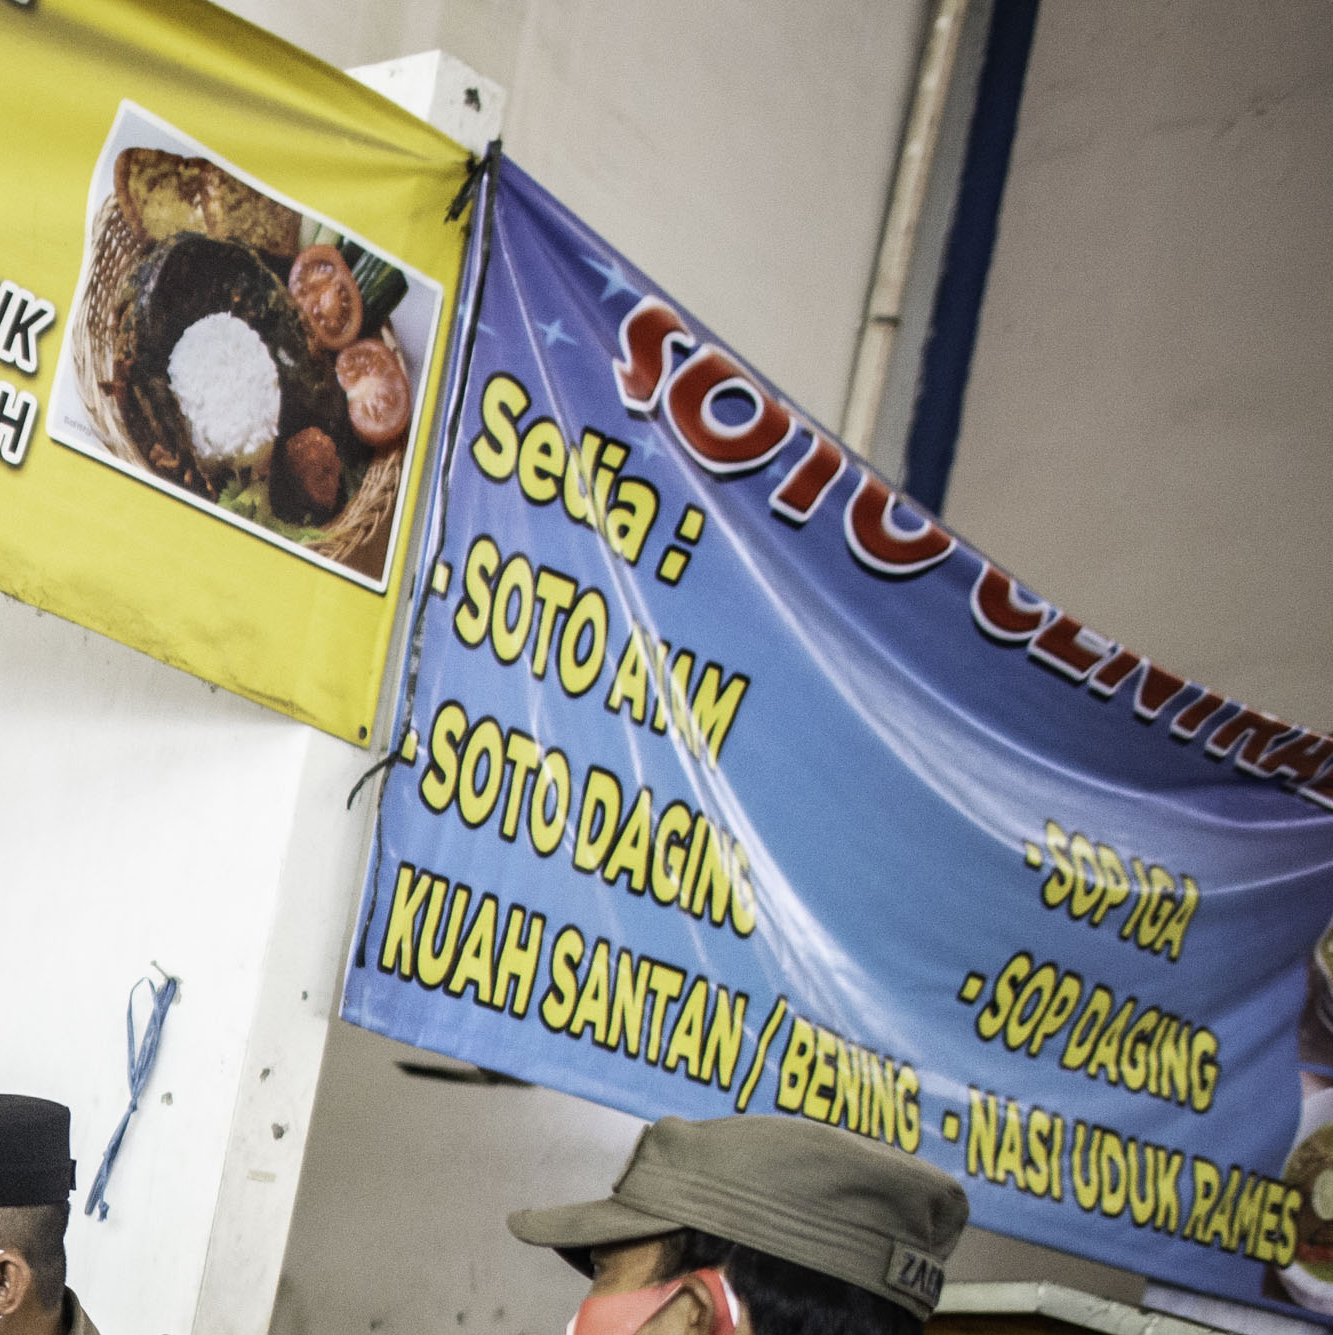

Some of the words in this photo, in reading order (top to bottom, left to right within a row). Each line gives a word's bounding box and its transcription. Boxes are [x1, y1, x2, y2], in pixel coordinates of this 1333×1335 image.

[573, 765, 758, 938] DAGING
[1119, 854, 1201, 963] IGA
[378, 861, 546, 1021] KUAH
[539, 923, 749, 1096] SANTAN
[775, 1015, 922, 1154] BENING
[1059, 981, 1220, 1114] DAGING
[1070, 1119, 1184, 1235] UDUK
[1183, 1153, 1304, 1271] RAMES
